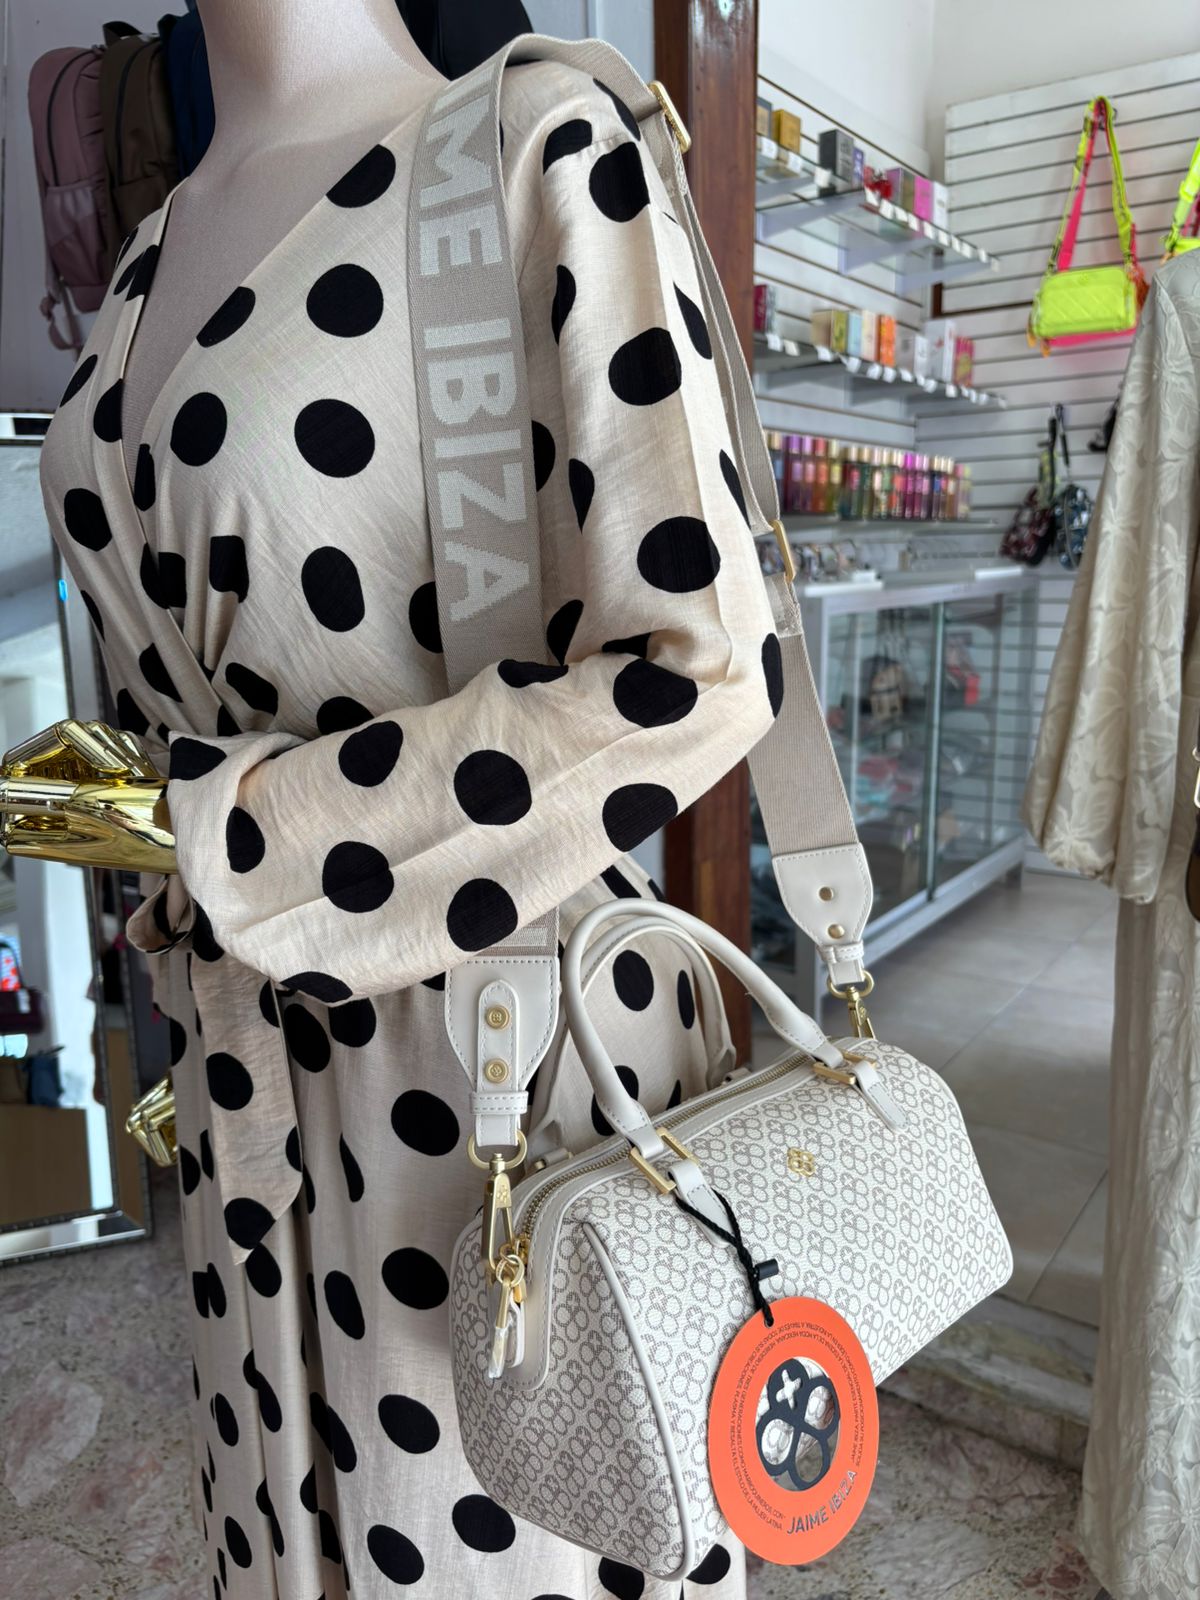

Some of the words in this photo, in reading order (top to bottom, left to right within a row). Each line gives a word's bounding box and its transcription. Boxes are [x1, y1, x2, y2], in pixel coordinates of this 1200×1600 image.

[424, 318, 529, 622] IBIZA
[787, 1506, 829, 1534] JAIME
[829, 1470, 857, 1514] IBIZA
